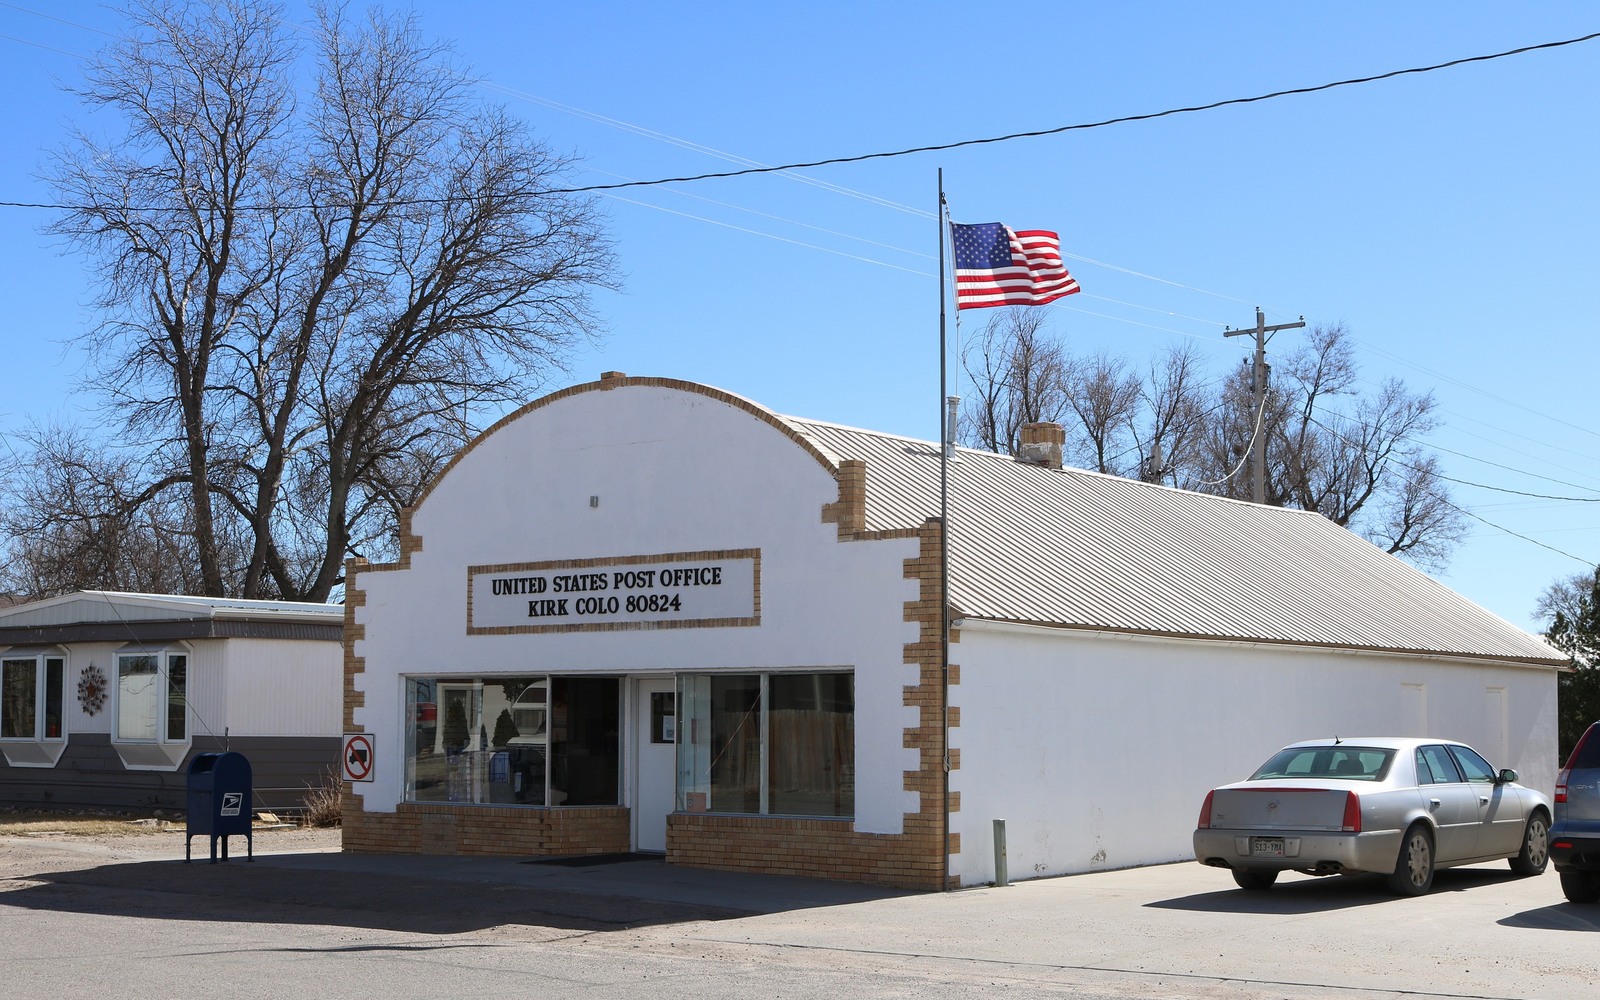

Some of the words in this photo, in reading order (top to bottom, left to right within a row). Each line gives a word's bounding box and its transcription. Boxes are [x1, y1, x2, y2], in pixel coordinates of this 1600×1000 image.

[492, 576, 547, 595] UNITED
[553, 573, 608, 592] STATES
[613, 571, 655, 589] POST
[660, 567, 722, 587] OFFICE
[528, 599, 569, 617] KIRK
[576, 597, 619, 615] COLO
[626, 593, 681, 613] 80824
